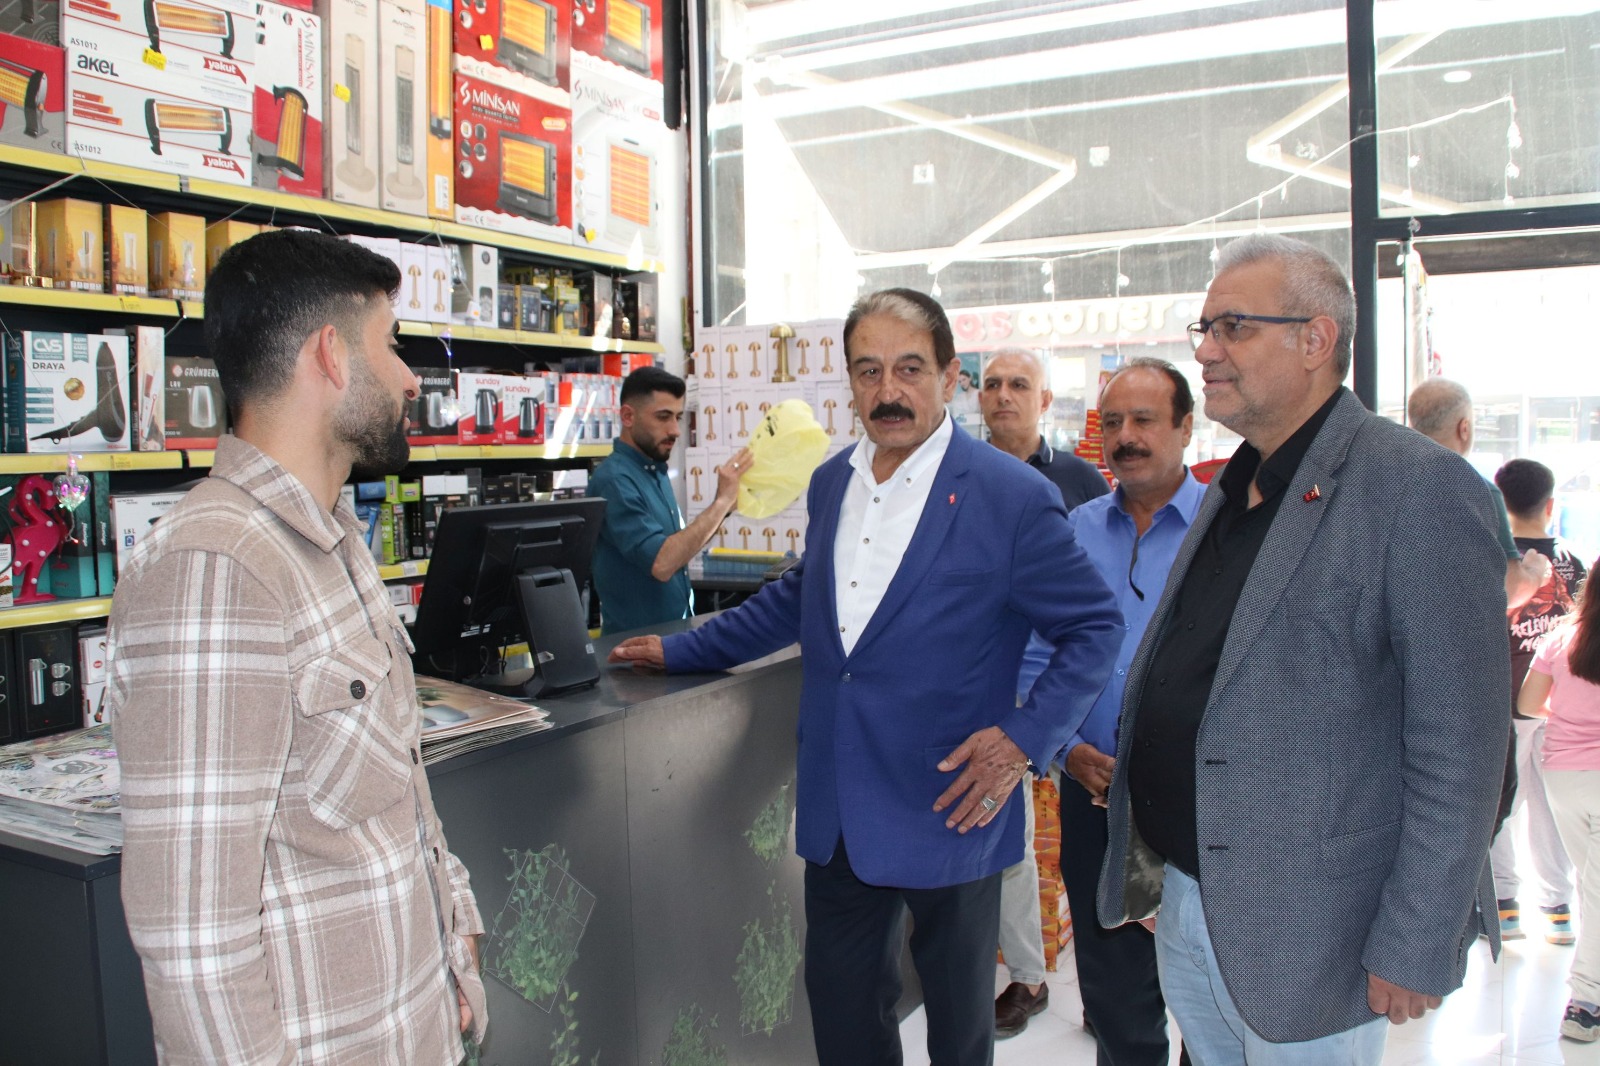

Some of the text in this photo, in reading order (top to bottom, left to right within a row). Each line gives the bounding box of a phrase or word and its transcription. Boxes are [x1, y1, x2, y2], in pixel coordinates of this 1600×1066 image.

[70, 37, 98, 51] AS1012
[208, 59, 237, 74] yakut
[75, 143, 102, 155] AS1012
[206, 156, 235, 170] yakut
[32, 362, 65, 370] DRAYA
[505, 384, 531, 394] sunday
